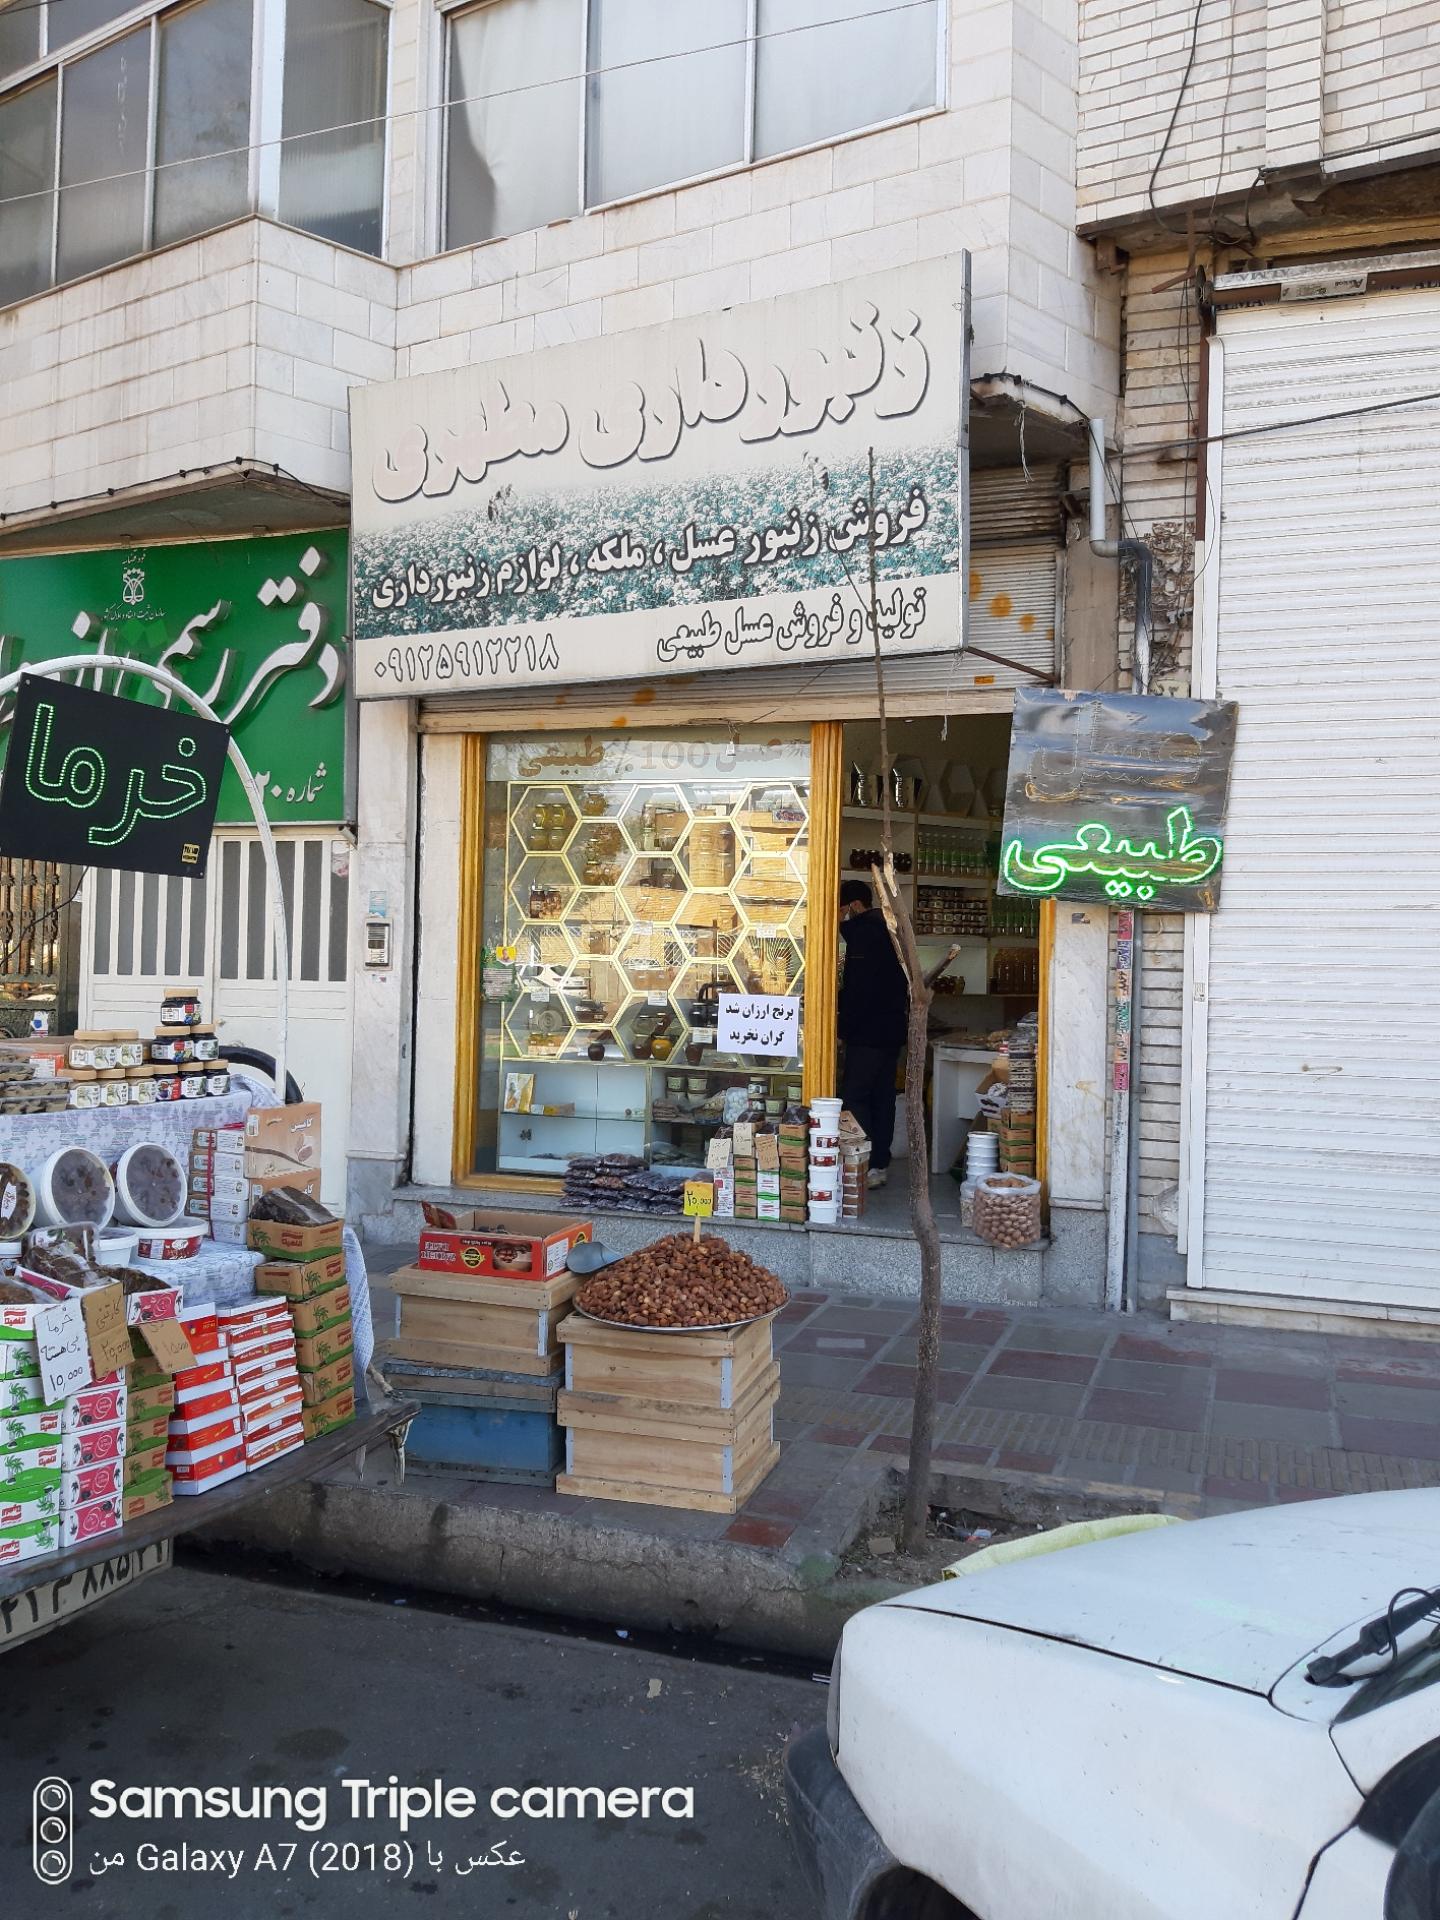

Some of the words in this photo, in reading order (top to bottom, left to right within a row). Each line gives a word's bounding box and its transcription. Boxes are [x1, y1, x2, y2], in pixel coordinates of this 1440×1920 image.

[743, 508, 821, 565] زنبور
[827, 486, 928, 551] فروش
[496, 543, 561, 595] لوازم
[586, 534, 646, 573] ملکه
[670, 522, 737, 573] عسل
[372, 555, 490, 609] زنبورداری
[656, 610, 722, 662] طبیعی
[724, 606, 774, 655] عسل
[776, 593, 844, 650] فروش
[845, 609, 862, 644] و
[866, 586, 927, 640] تولید
[25, 703, 207, 846] خرما
[286, 761, 328, 803] شماره
[1003, 805, 1223, 901] طبیعی
[725, 1002, 740, 1014] شد
[742, 1003, 770, 1019] ارزان
[772, 1003, 794, 1020] برنج
[729, 1029, 759, 1045] نخرید
[46, 1306, 74, 1336] خرما
